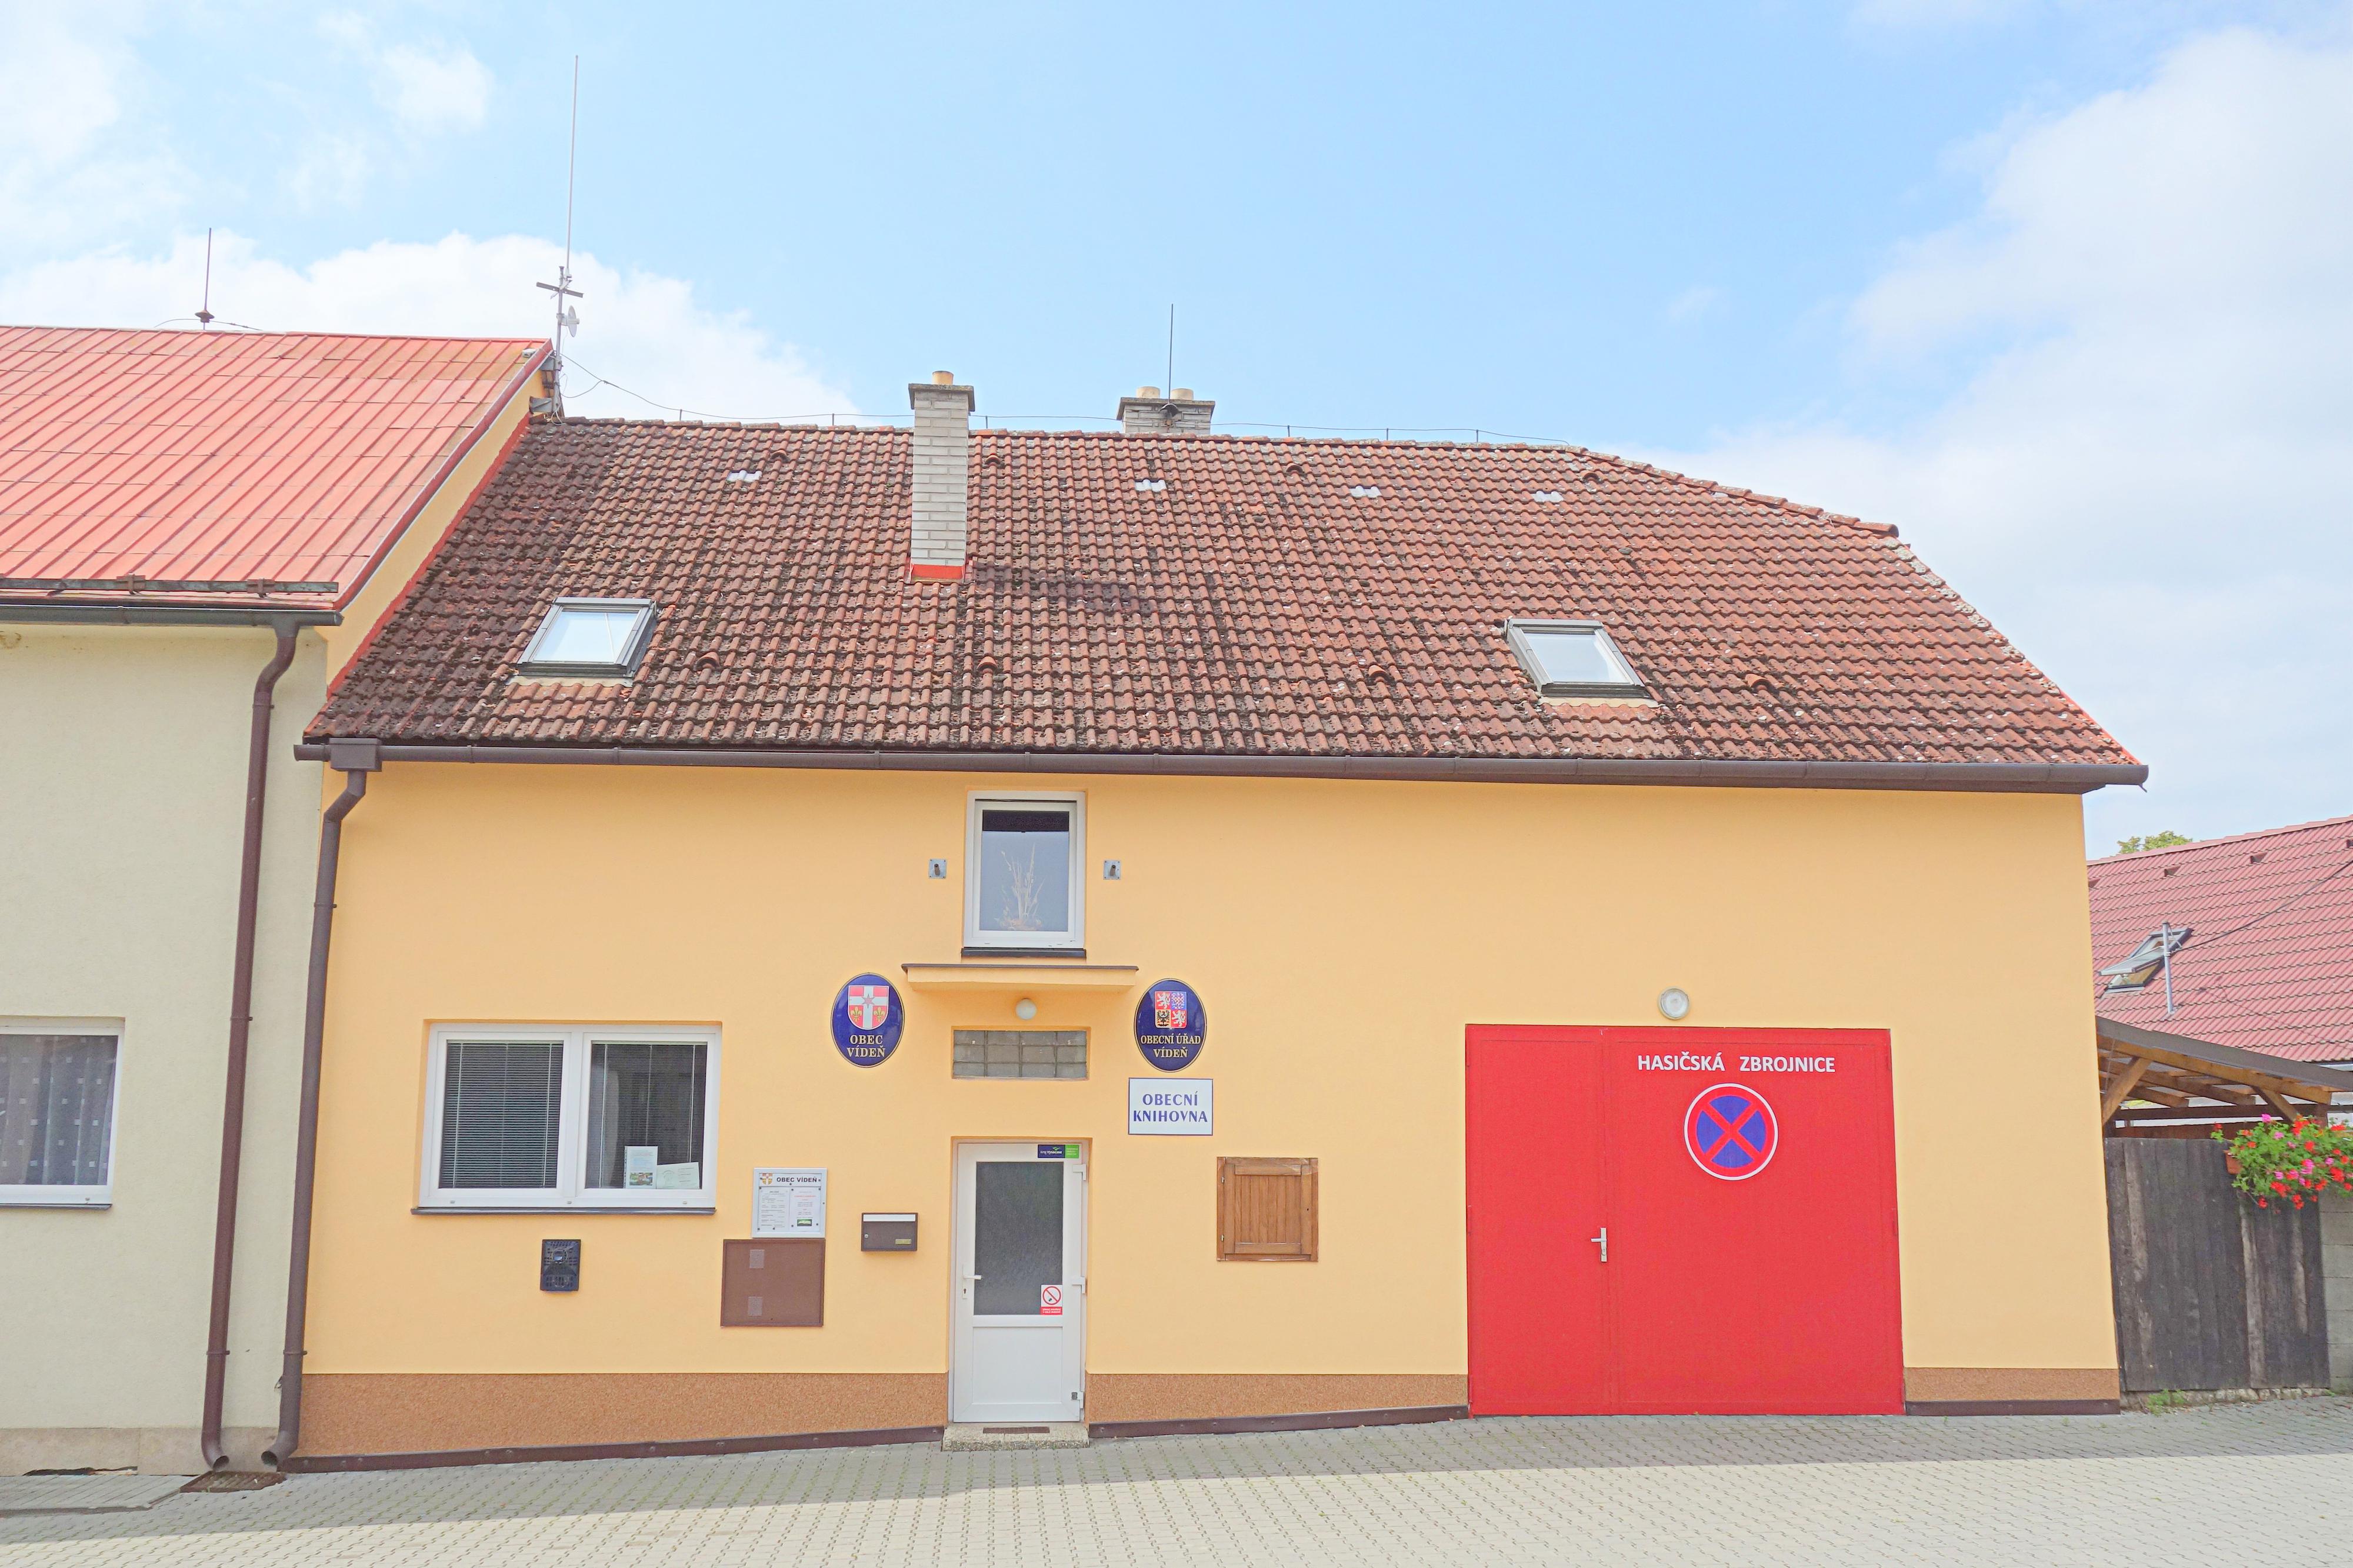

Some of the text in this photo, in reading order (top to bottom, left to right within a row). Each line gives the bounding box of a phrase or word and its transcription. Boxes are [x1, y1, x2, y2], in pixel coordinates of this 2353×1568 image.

[849, 1035, 883, 1045] OBEC
[1141, 1033, 1201, 1045] OBECNÍ ÚŘAD
[846, 1045, 885, 1057] VÍDEŇ
[1153, 1046, 1188, 1057] VÍDEŇ
[1638, 1051, 1835, 1072] HASIČSKÁ ZBROJNICE
[1142, 1091, 1198, 1106] OBECNÍ
[1134, 1110, 1208, 1122] KNIHOVNA
